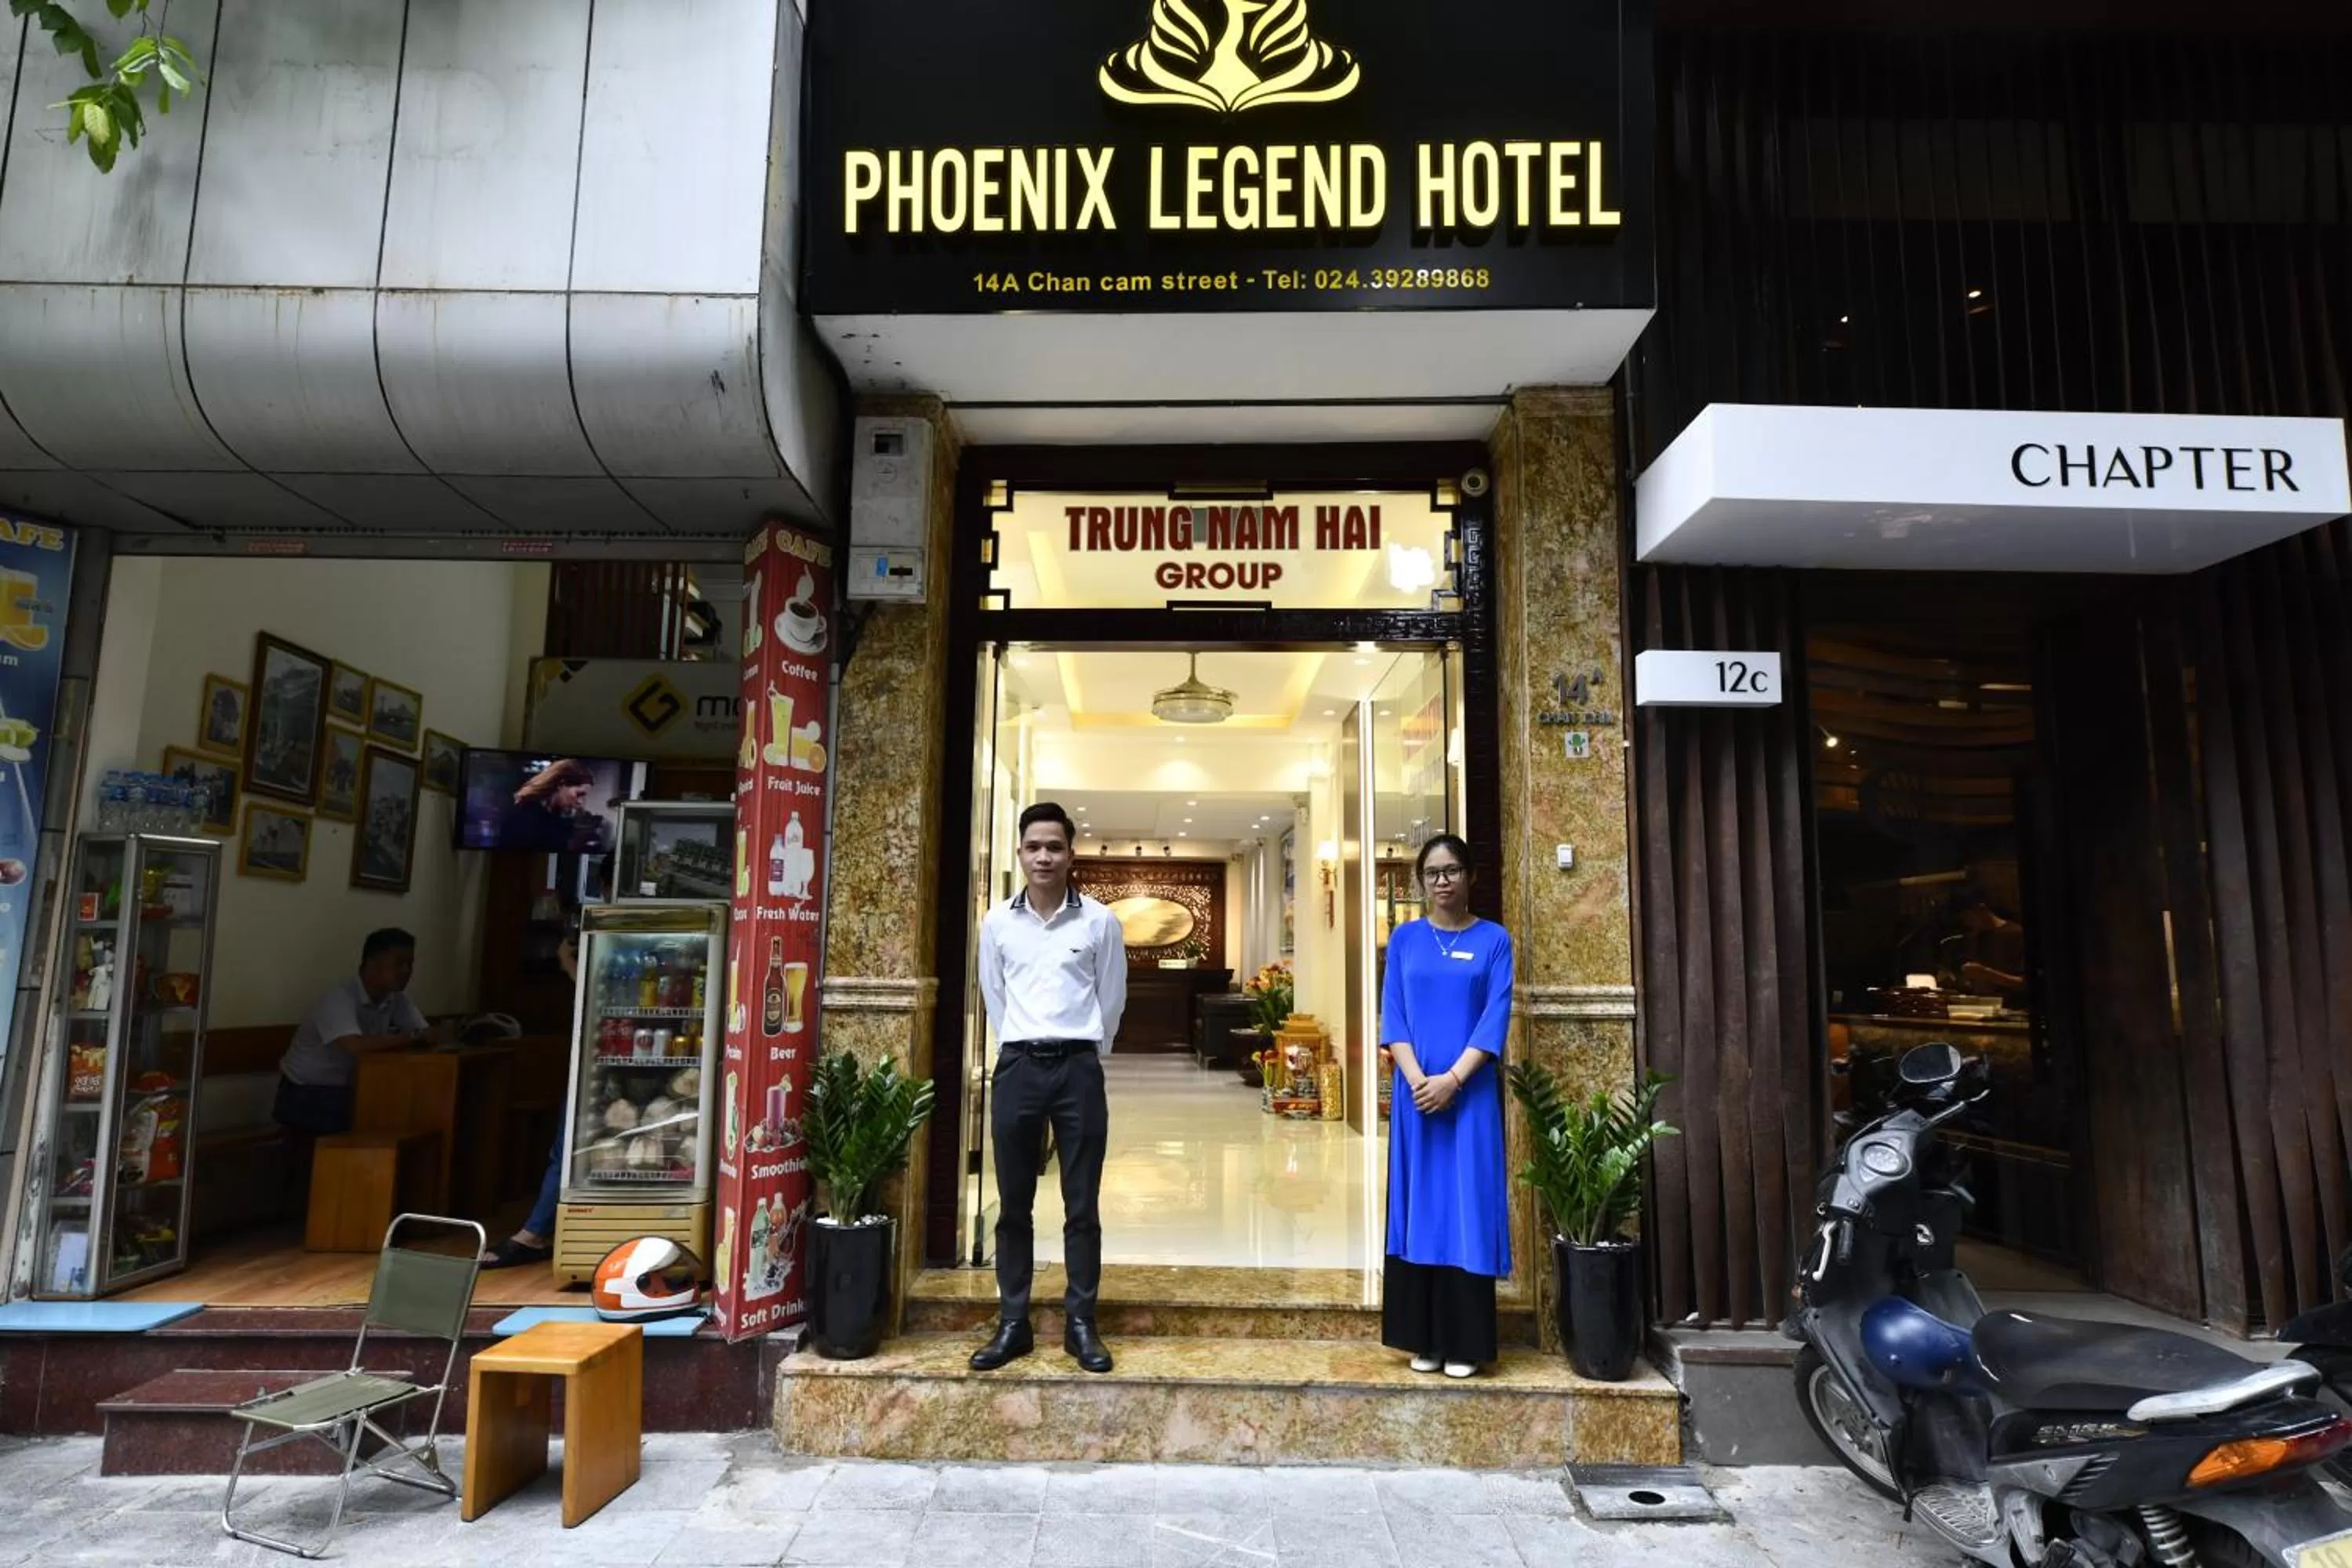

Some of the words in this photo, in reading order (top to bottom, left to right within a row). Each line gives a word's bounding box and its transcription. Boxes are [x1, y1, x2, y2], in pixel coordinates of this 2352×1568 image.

[844, 147, 1117, 233] PHOENIX
[1149, 144, 1386, 230] LEGEND
[1418, 140, 1621, 227] HOTEL
[973, 272, 1019, 292] 14A
[1028, 271, 1091, 292] Chan
[1100, 276, 1152, 291] cam
[1161, 271, 1238, 291] street
[1262, 270, 1306, 289] Tel:
[1315, 268, 1490, 289] 024.39289868
[2011, 443, 2299, 492] CHAPTER
[1065, 506, 1193, 551] TRUNG
[1206, 505, 1300, 550] NAM
[1316, 505, 1381, 550] HAI
[1155, 562, 1283, 590] GROUP
[782, 659, 818, 682] Coffee
[1715, 661, 1768, 693] 12c
[756, 906, 785, 920] Fresh
[788, 906, 819, 921] Water
[770, 1047, 797, 1060] Beer
[740, 1308, 768, 1329] Soft
